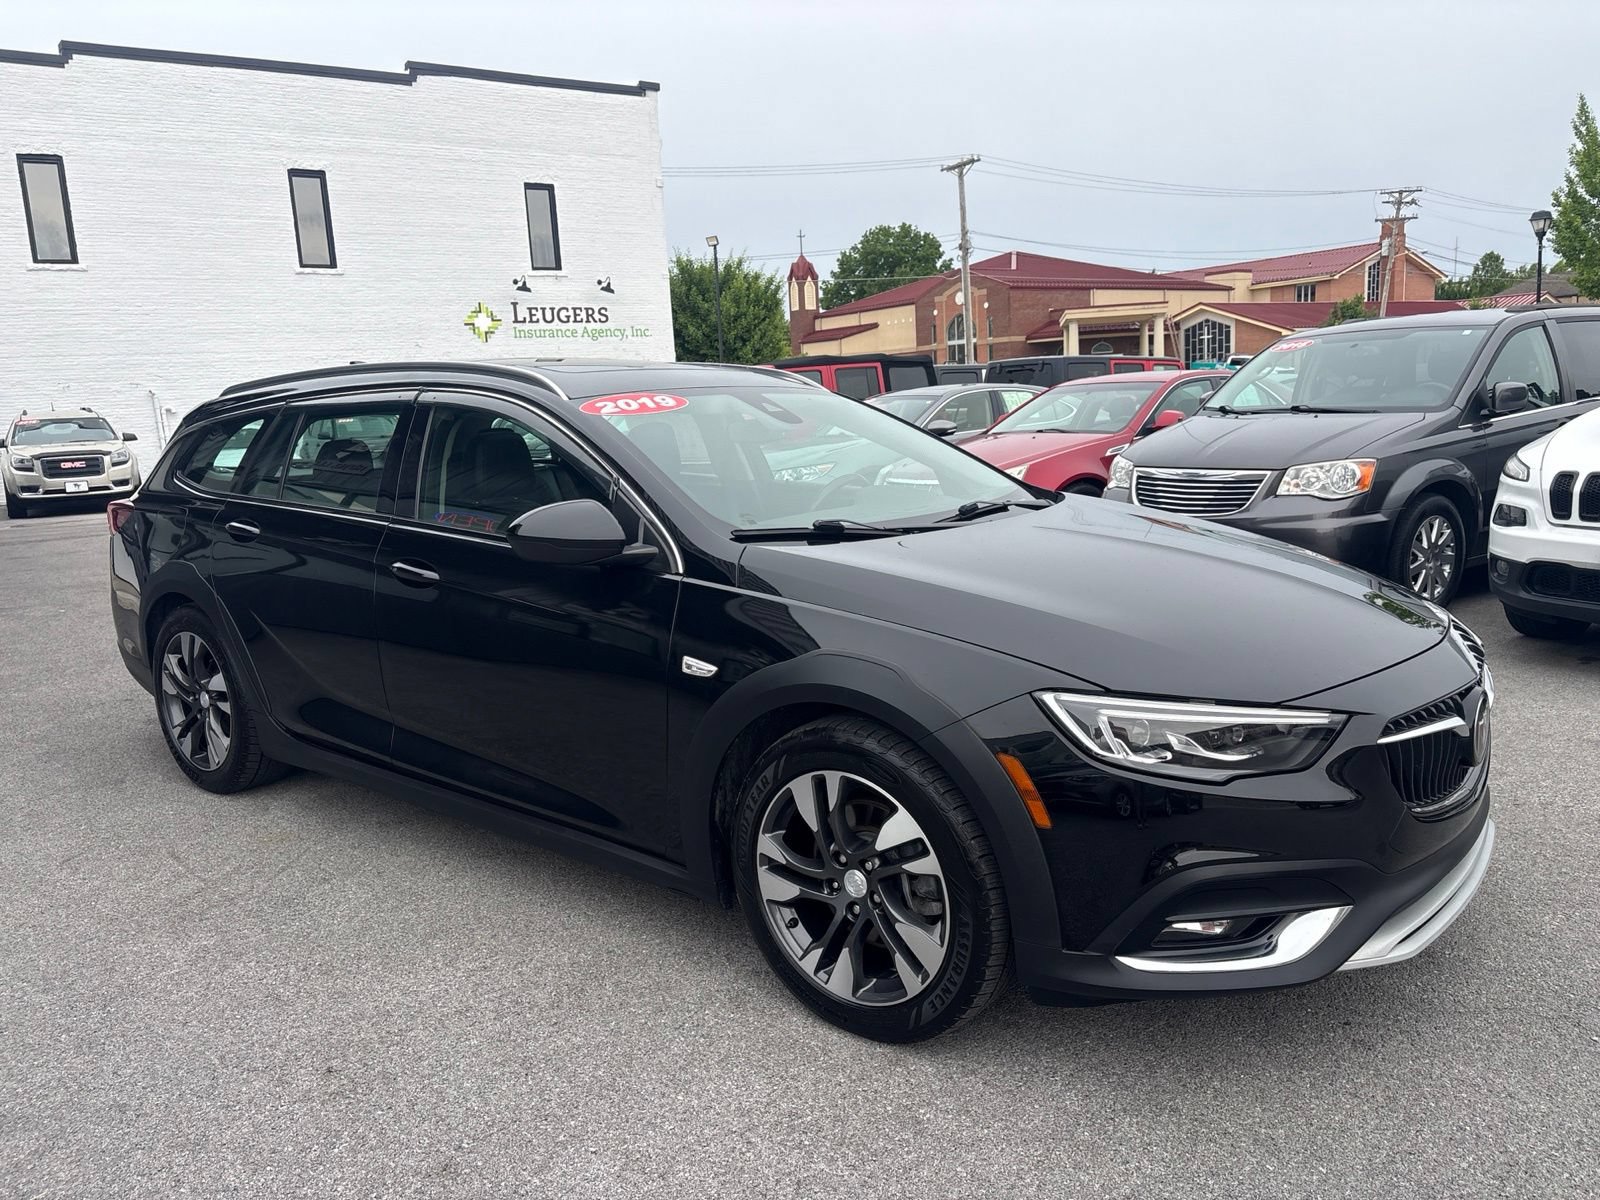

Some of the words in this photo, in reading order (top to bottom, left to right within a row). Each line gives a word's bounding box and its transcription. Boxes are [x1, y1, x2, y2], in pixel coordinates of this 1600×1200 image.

[510, 301, 609, 324] LEUGERS
[512, 326, 578, 339] Insurance
[580, 326, 629, 342] Agency,
[630, 326, 653, 338] Inc.
[594, 395, 678, 414] 2019
[60, 461, 87, 469] GMC
